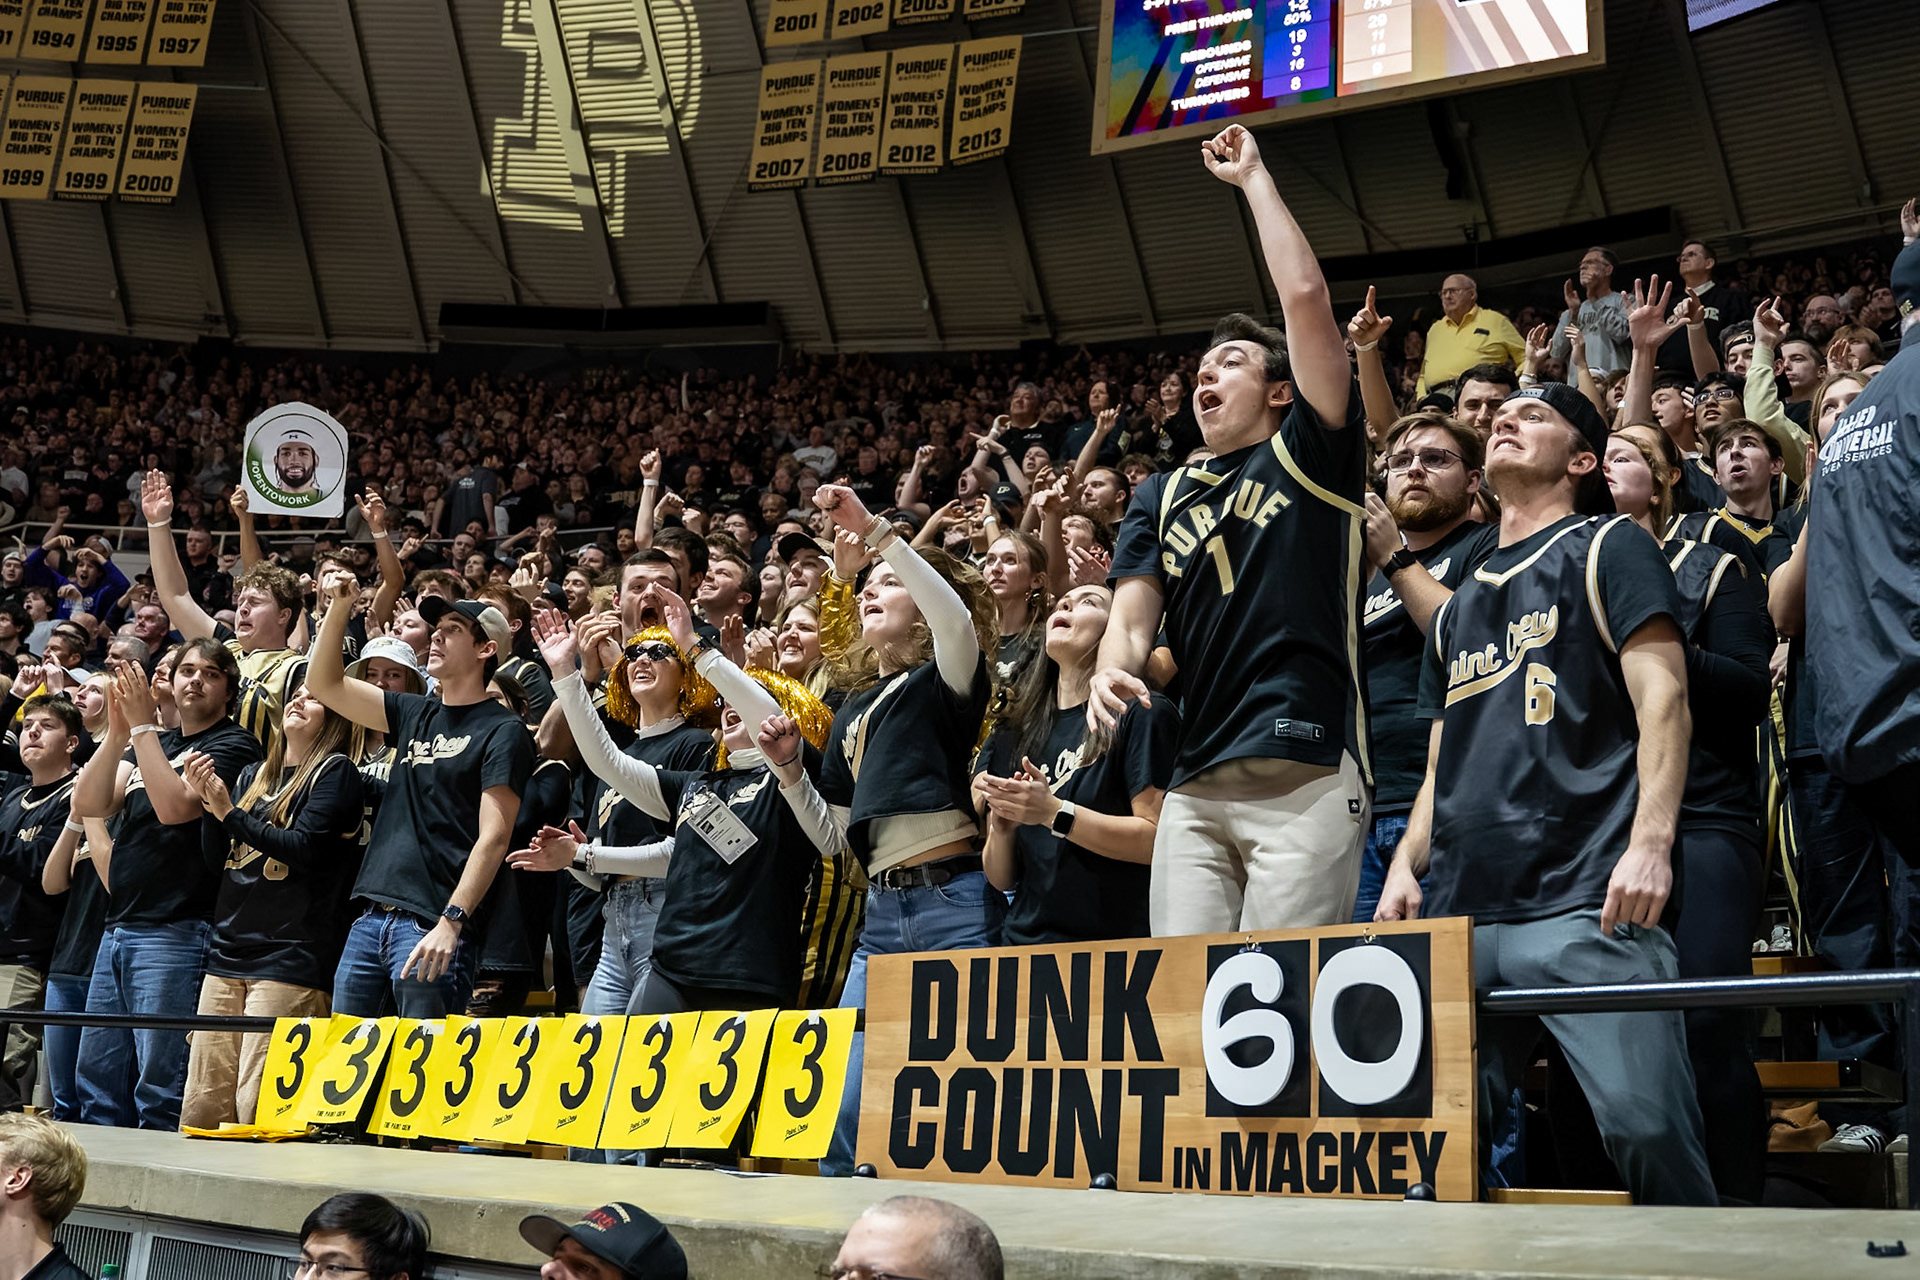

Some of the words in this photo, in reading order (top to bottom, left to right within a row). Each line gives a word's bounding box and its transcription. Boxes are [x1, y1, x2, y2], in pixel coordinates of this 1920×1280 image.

[37, 7, 83, 19] CHAMPS
[105, 0, 122, 9] BIG
[127, 1, 147, 10] TEN
[167, 2, 184, 11] BIG
[189, 3, 208, 13] TEN
[101, 11, 146, 22] CHAMPS
[162, 13, 208, 24] CHAMPS
[774, 12, 818, 33] 2001
[838, 3, 884, 26] 2002
[1164, 19, 1197, 36] FREE
[1198, 8, 1253, 29] THROWS
[33, 31, 75, 47] 1994
[97, 36, 138, 51] 1995
[1289, 29, 1307, 44] 19
[1371, 28, 1385, 42] 11
[159, 38, 200, 54] 1997
[1180, 40, 1252, 64] REBOUNDS
[1291, 45, 1302, 57] 3
[963, 48, 1016, 67] PURDUE
[1195, 54, 1251, 75] OFFENSIVE
[1289, 57, 1305, 71] 16
[830, 66, 881, 82] PURDUE
[896, 58, 947, 75] PURDUE
[766, 74, 816, 91] PURDUE
[959, 76, 1013, 96] WOMEN'S
[1194, 68, 1251, 89] DEFENSIVE
[1290, 76, 1302, 91] 8
[16, 90, 66, 103] PURDUE
[79, 93, 128, 106] PURDUE
[141, 96, 191, 109] PURDUE
[826, 98, 880, 112] WOMEN'S
[890, 90, 944, 104] WOMEN'S
[963, 96, 981, 108] BIG
[985, 89, 1005, 104] TEN
[1171, 86, 1251, 111] TURNOVERS
[761, 104, 814, 121] WOMEN'S
[829, 114, 847, 125] BIG
[852, 112, 874, 123] TEN
[894, 105, 913, 117] BIG
[918, 104, 938, 116] TEN
[959, 101, 1006, 121] CHAMPS
[9, 119, 61, 131] WOMEN'S
[72, 122, 123, 135] WOMEN'S
[134, 125, 187, 137] WOMEN'S
[765, 122, 782, 134] BIG
[786, 118, 806, 130] TEN
[826, 125, 875, 138] CHAMPS
[890, 117, 939, 130] CHAMPS
[10, 131, 28, 142] BIG
[32, 132, 53, 143] TEN
[74, 135, 92, 146] BIG
[95, 136, 116, 147] TEN
[136, 138, 153, 148] BIG
[158, 139, 179, 149] TEN
[761, 131, 807, 146] CHAMPS
[959, 128, 1002, 154] 2013
[5, 143, 52, 156] CHAMPS
[69, 147, 115, 159] CHAMPS
[132, 149, 178, 161] CHAMPS
[888, 145, 936, 163] 2012
[756, 158, 804, 179] 2007
[823, 152, 871, 173] 2008
[2, 169, 44, 186] 1999
[66, 172, 108, 189] 1999
[125, 174, 173, 192] 2000
[1819, 421, 1896, 466] UNIVERSAL
[1844, 444, 1893, 463] SERVICES
[251, 460, 310, 505] #OPENTOWORK
[1206, 535, 1235, 597] 1
[1525, 662, 1556, 726] 6
[908, 949, 1164, 1062] DUNK
[1201, 944, 1424, 1106] 60
[276, 1023, 312, 1100] 3
[322, 1023, 381, 1106] 3
[444, 1024, 482, 1107] 3
[498, 1024, 540, 1110] 3
[559, 1020, 603, 1110] 3
[631, 1020, 674, 1113] 3
[699, 1016, 747, 1111] 3
[784, 1015, 828, 1119] 3
[390, 1024, 434, 1118] 3
[888, 1066, 1180, 1184] COUNT
[1173, 1146, 1211, 1190] IN
[1220, 1131, 1447, 1194] MACKEY
